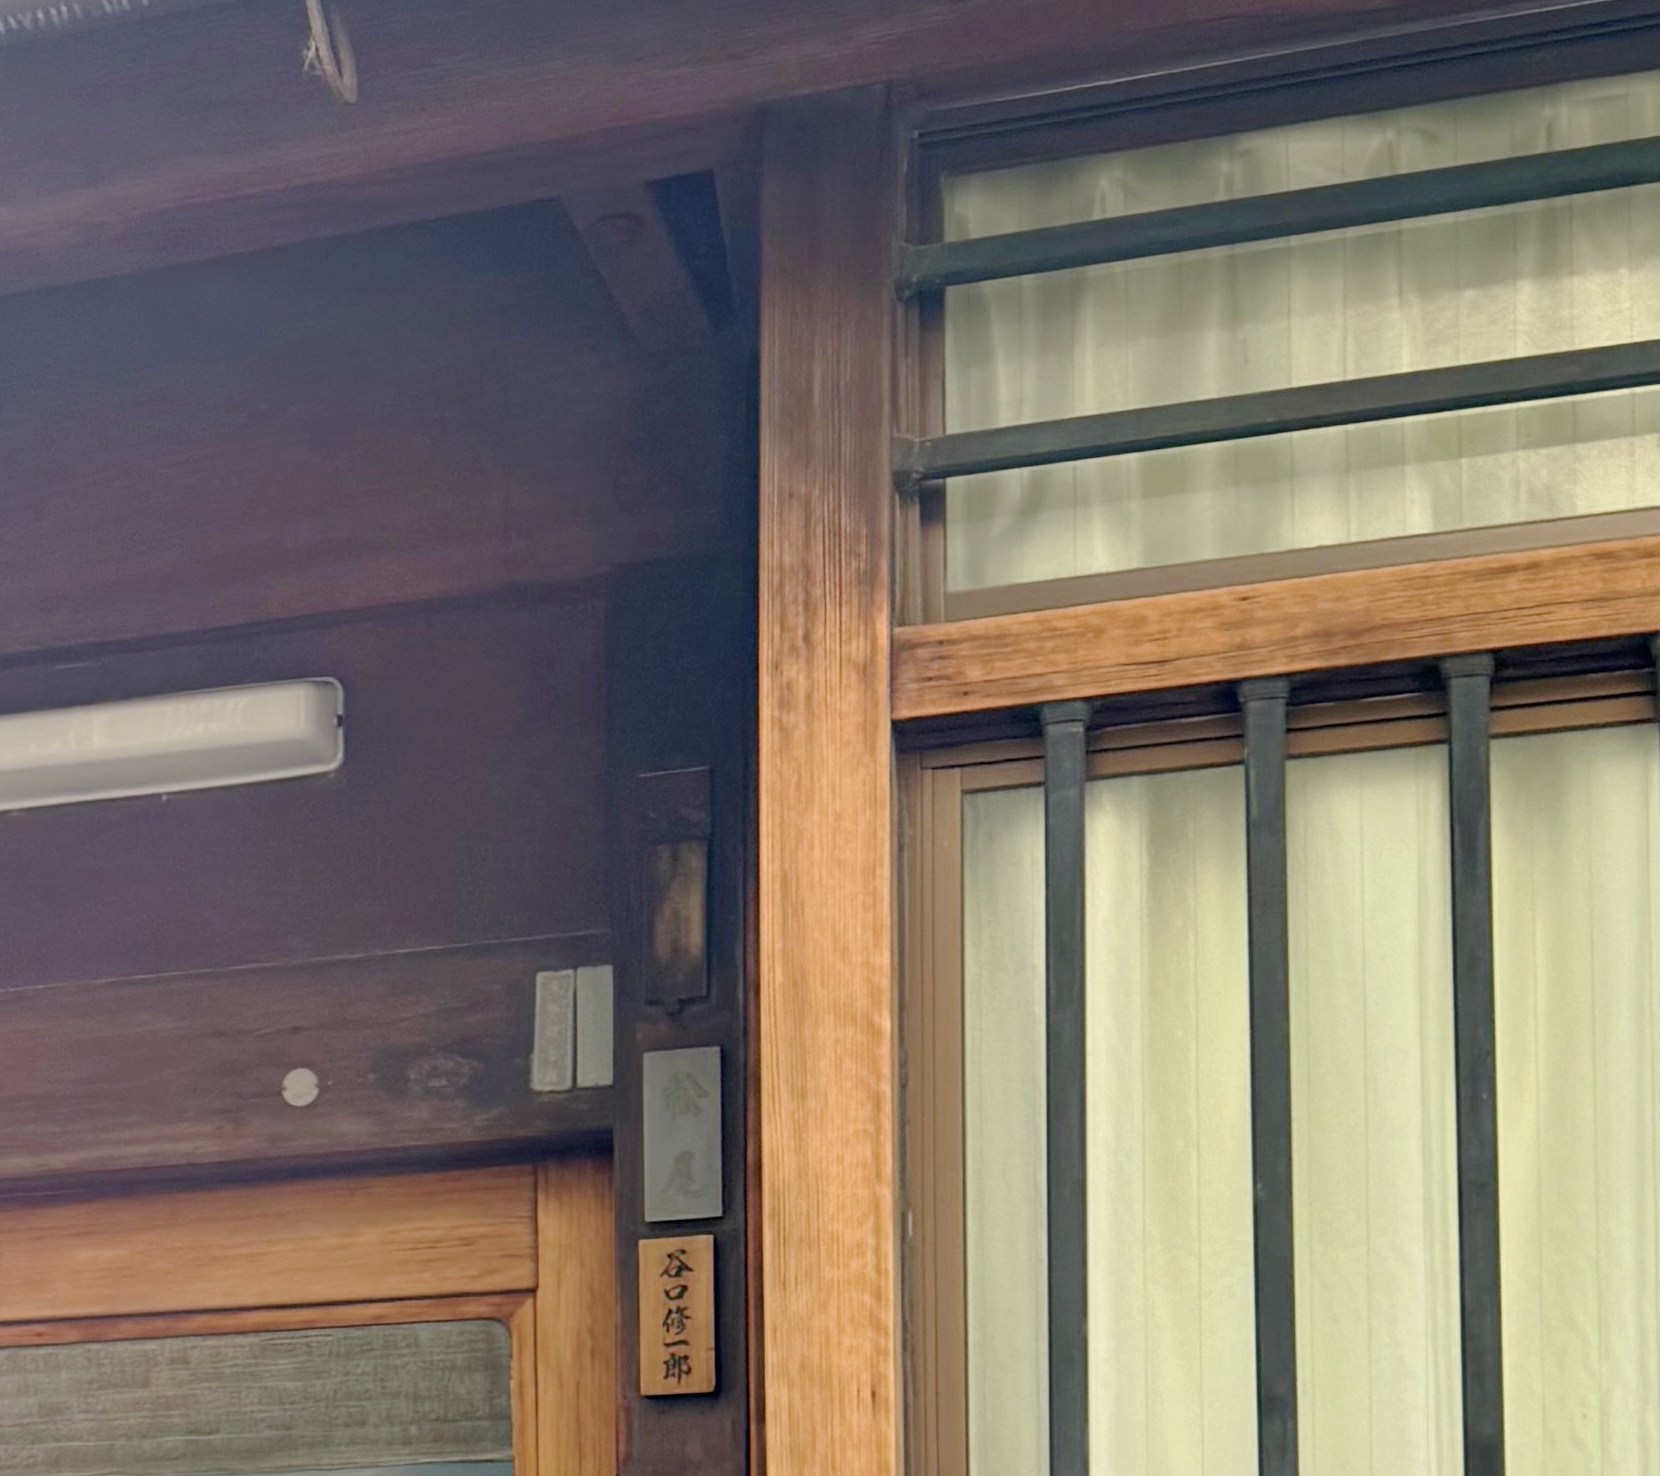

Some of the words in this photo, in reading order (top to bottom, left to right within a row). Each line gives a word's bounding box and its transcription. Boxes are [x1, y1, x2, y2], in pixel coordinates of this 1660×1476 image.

[660, 1248, 694, 1386] 谷口修一郎
